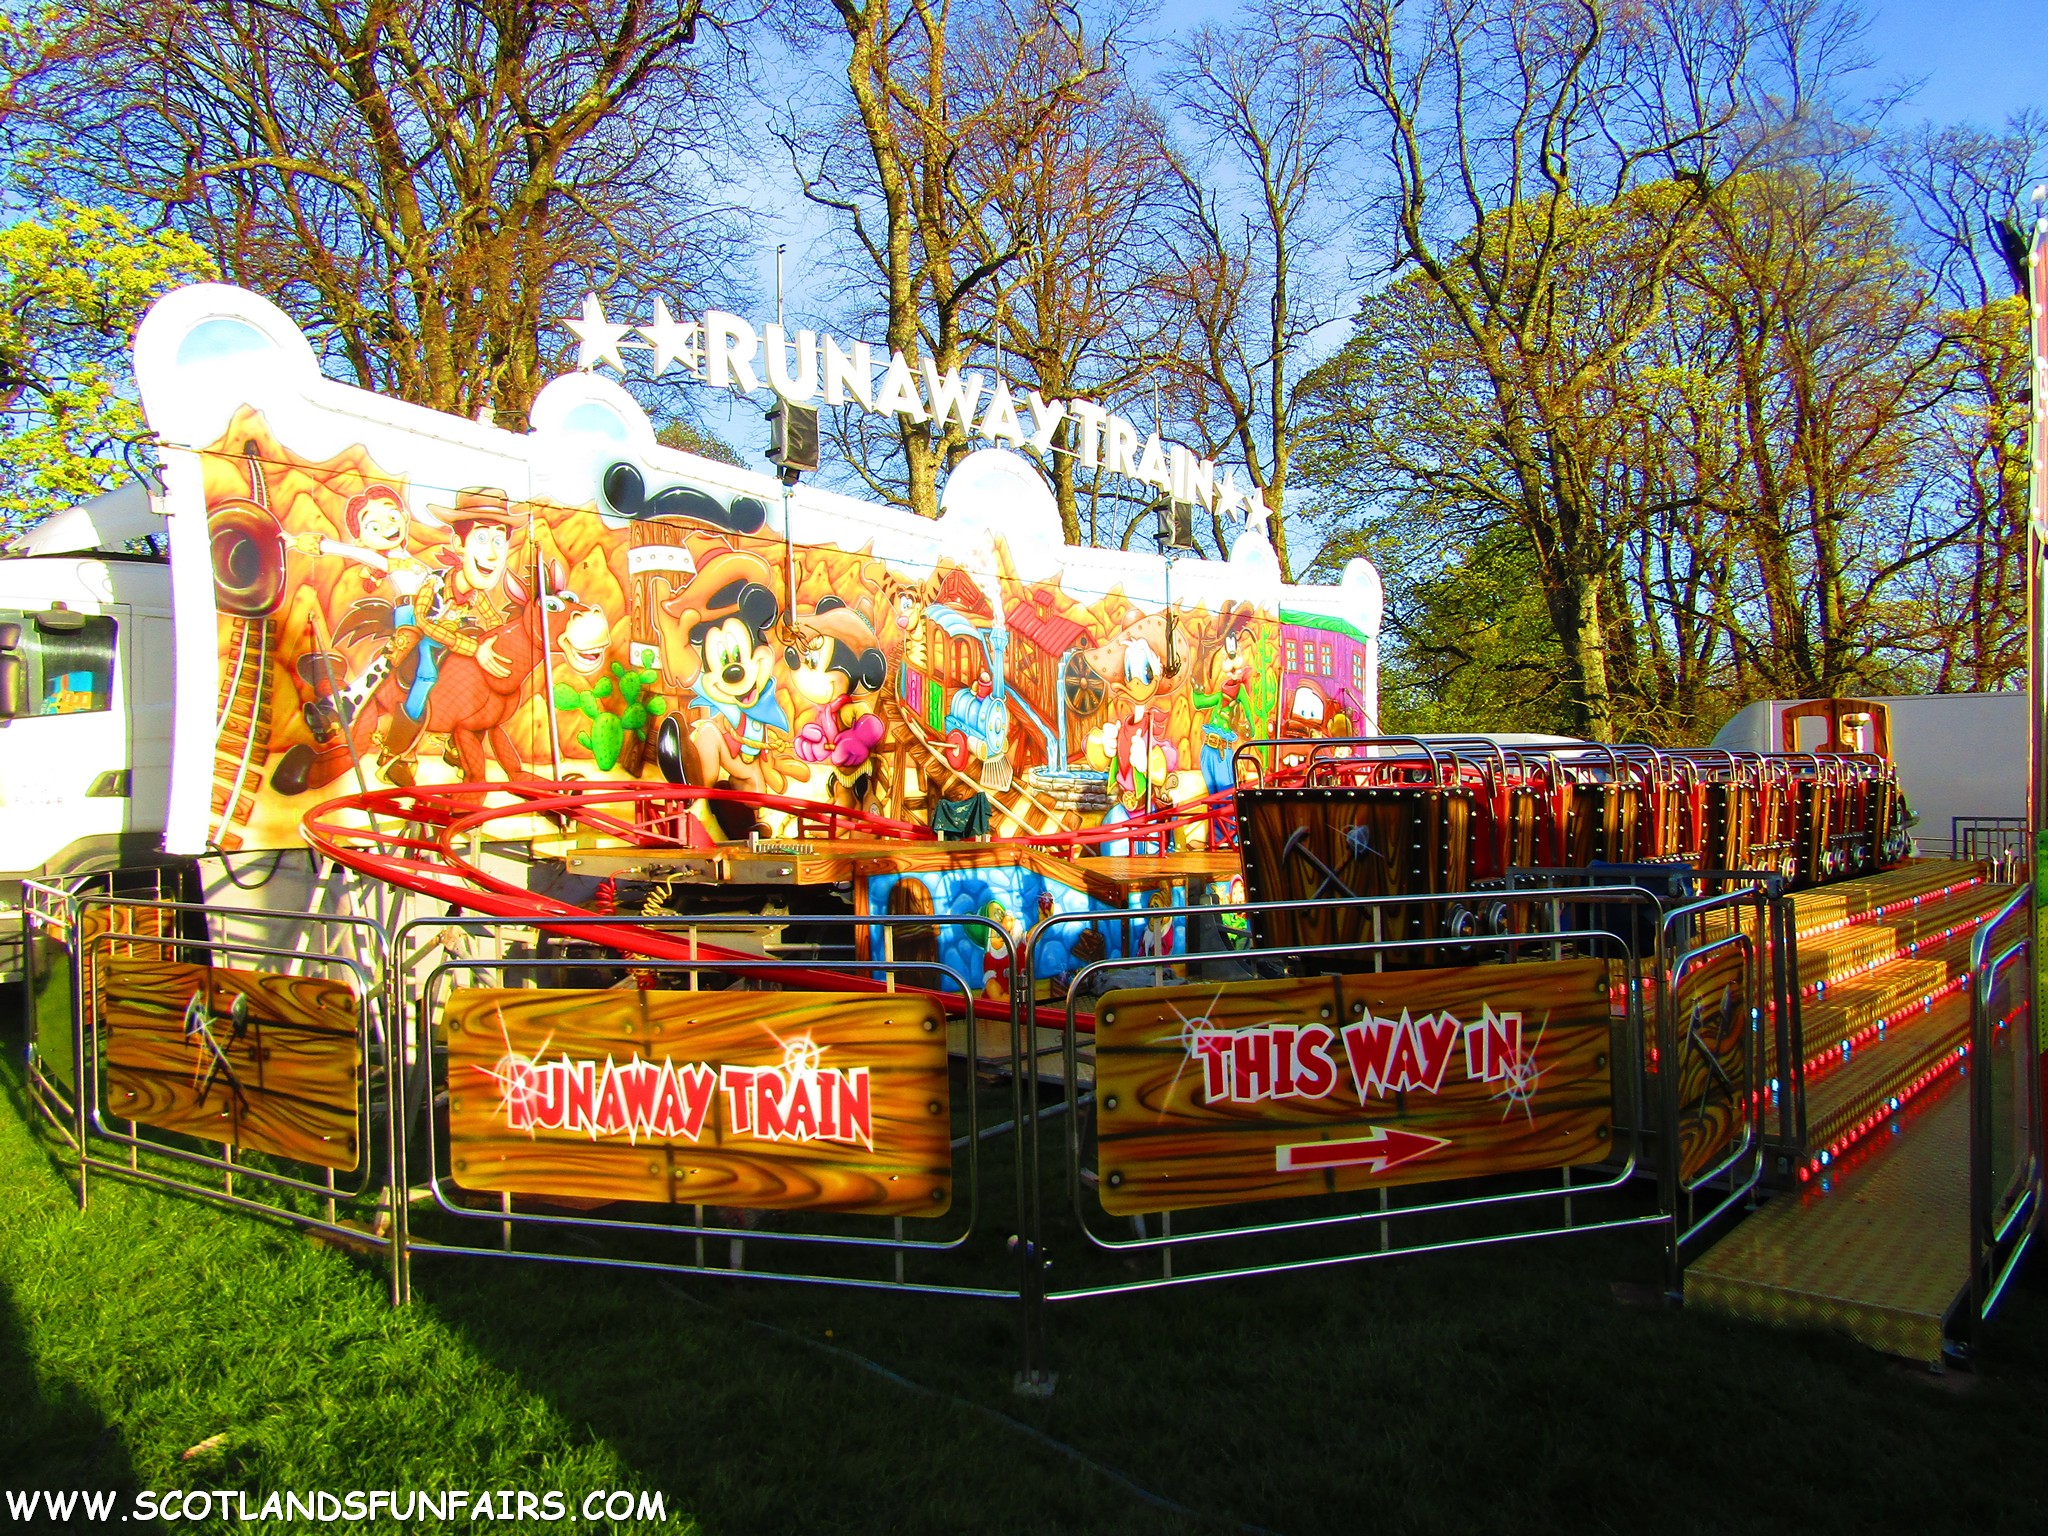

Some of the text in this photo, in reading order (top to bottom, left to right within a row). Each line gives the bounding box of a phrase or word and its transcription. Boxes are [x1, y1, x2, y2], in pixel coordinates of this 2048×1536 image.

[704, 310, 1215, 515] RUNAWAY TRAIN
[506, 1050, 874, 1153] RUNAWAY TRAIN
[1191, 1001, 1523, 1107] THIS WAY IN
